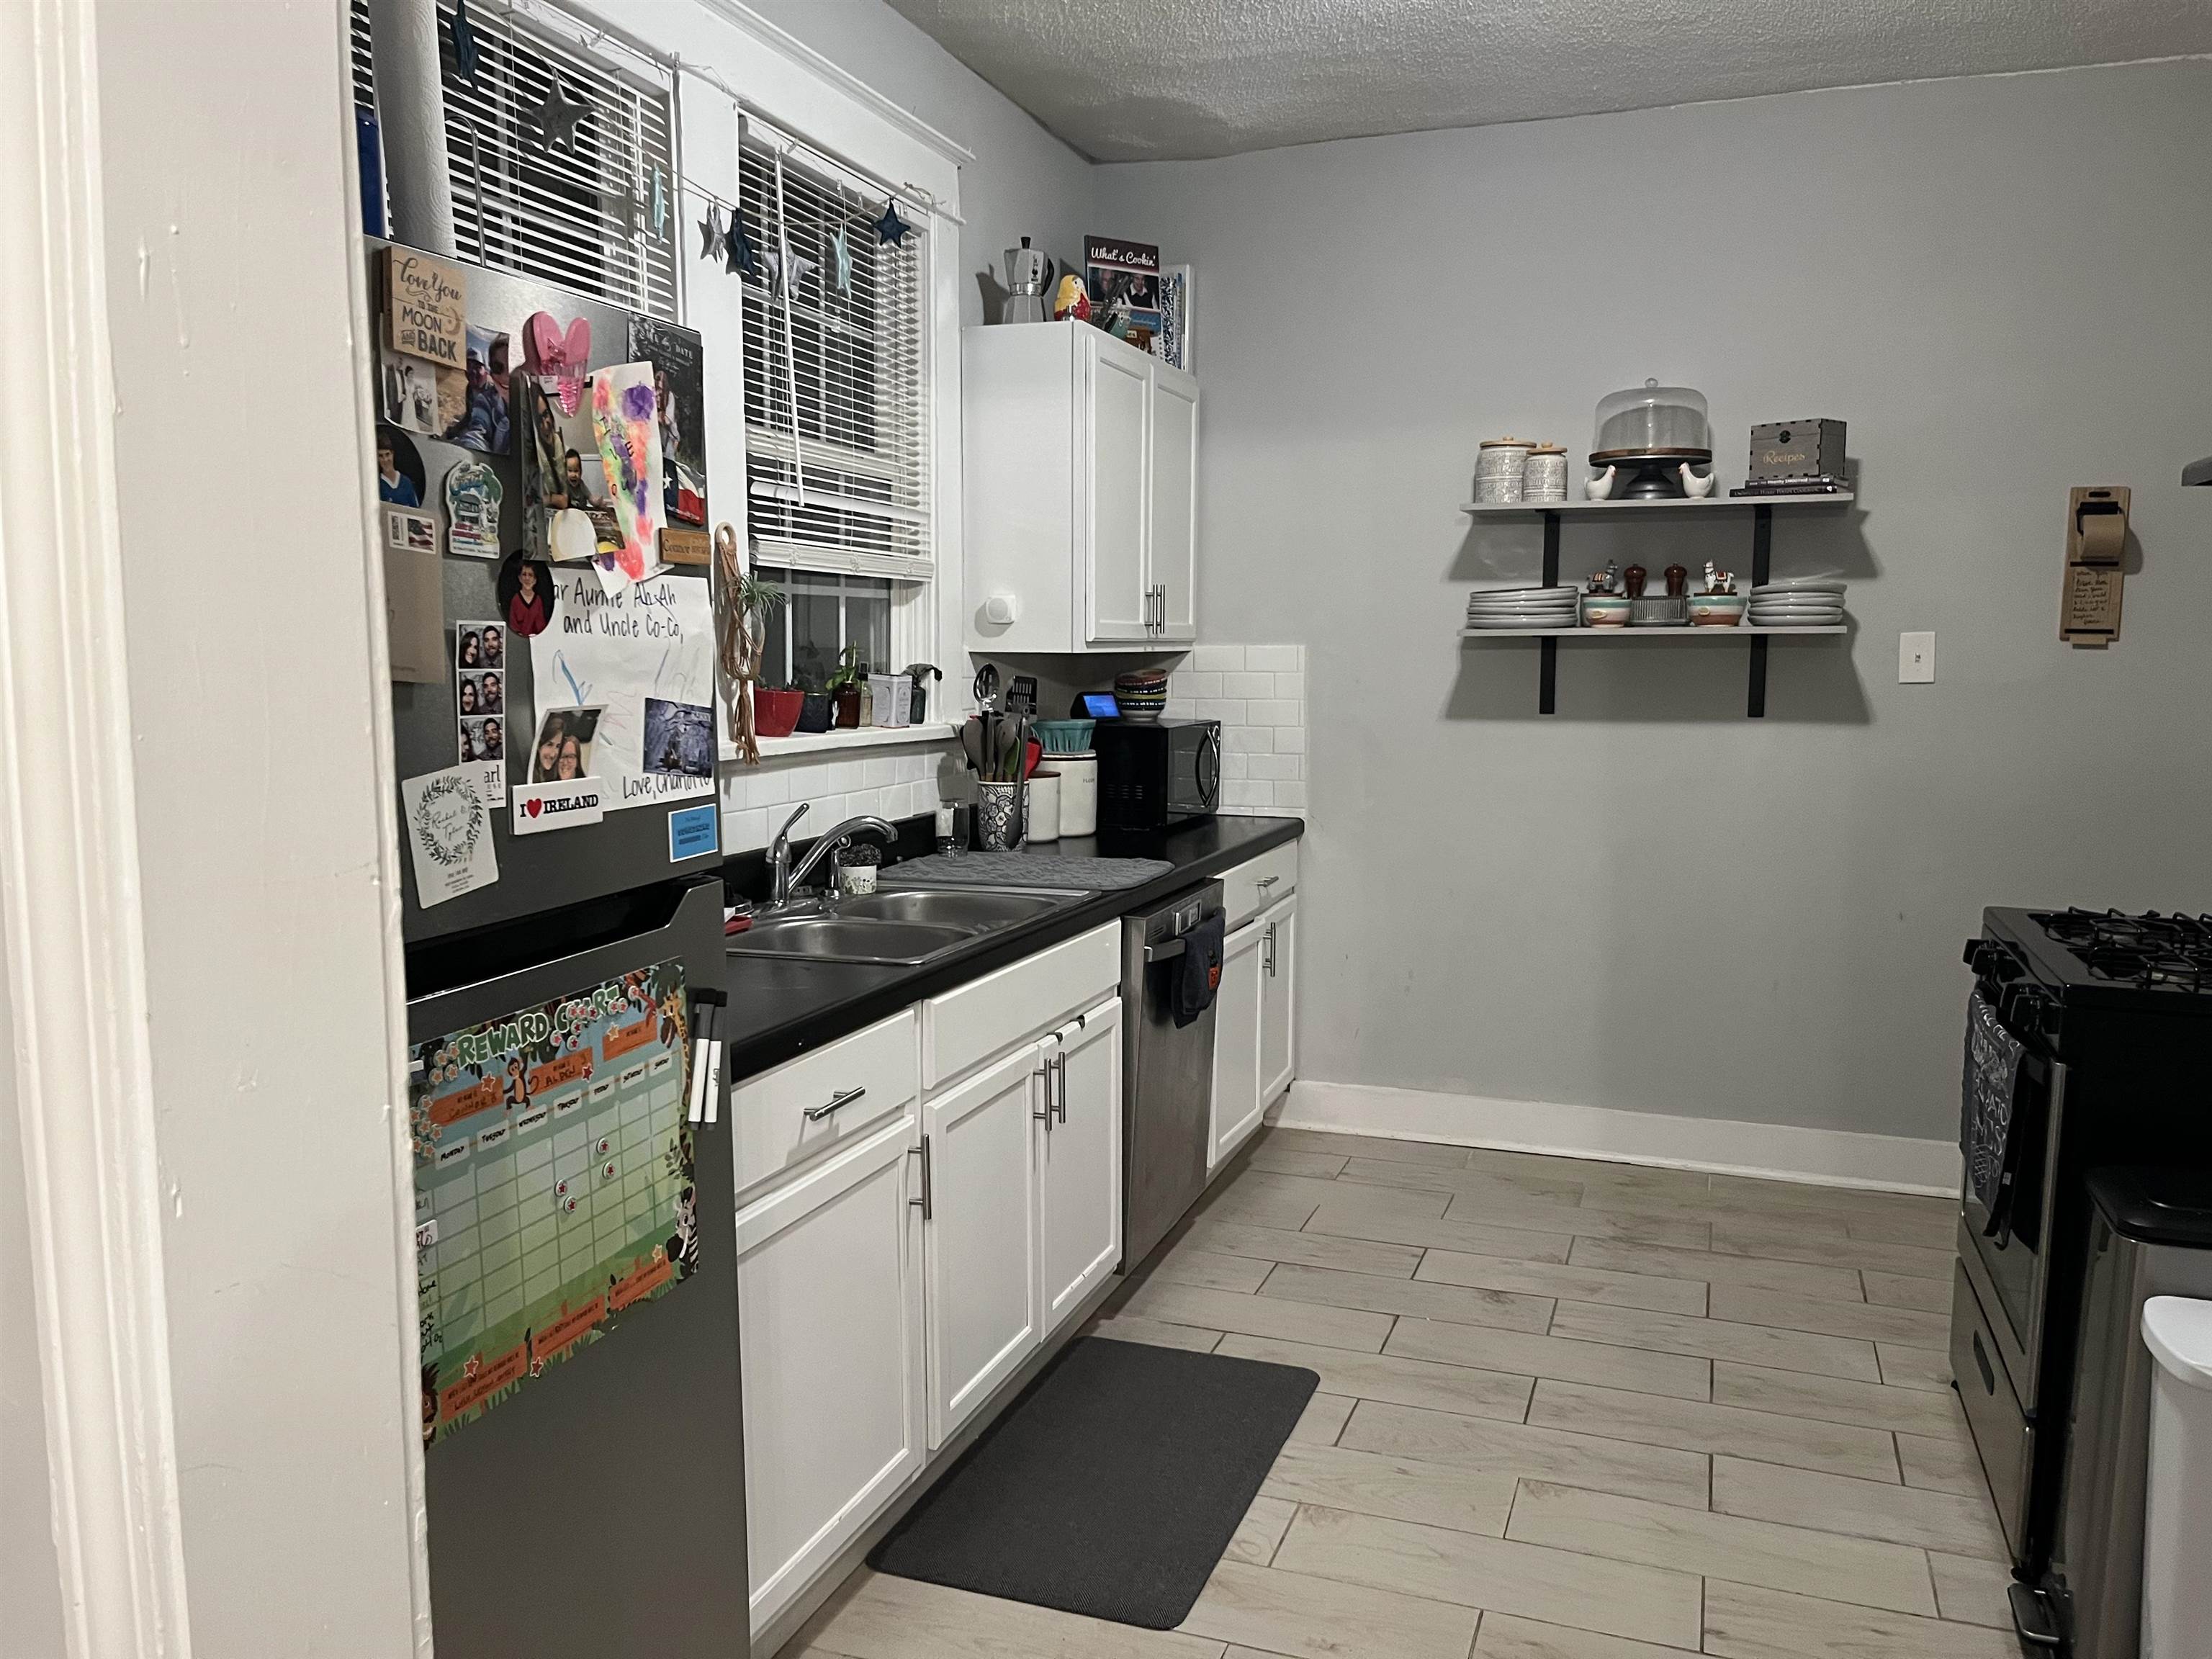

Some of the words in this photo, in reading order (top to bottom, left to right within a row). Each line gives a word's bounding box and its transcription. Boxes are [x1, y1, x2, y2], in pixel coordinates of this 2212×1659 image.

[1091, 246, 1125, 262] What's
[1125, 251, 1156, 266] Cookin'
[395, 257, 429, 290] Love
[432, 271, 463, 302] You
[402, 305, 442, 334] MOON
[418, 330, 457, 362] BACK
[1763, 450, 1806, 465] Recipes
[564, 610, 593, 634] and
[600, 613, 639, 638] Uncle
[623, 775, 657, 800] Love,
[520, 804, 526, 818] I
[543, 793, 599, 814] IRELAND
[457, 1012, 549, 1070] REWARD
